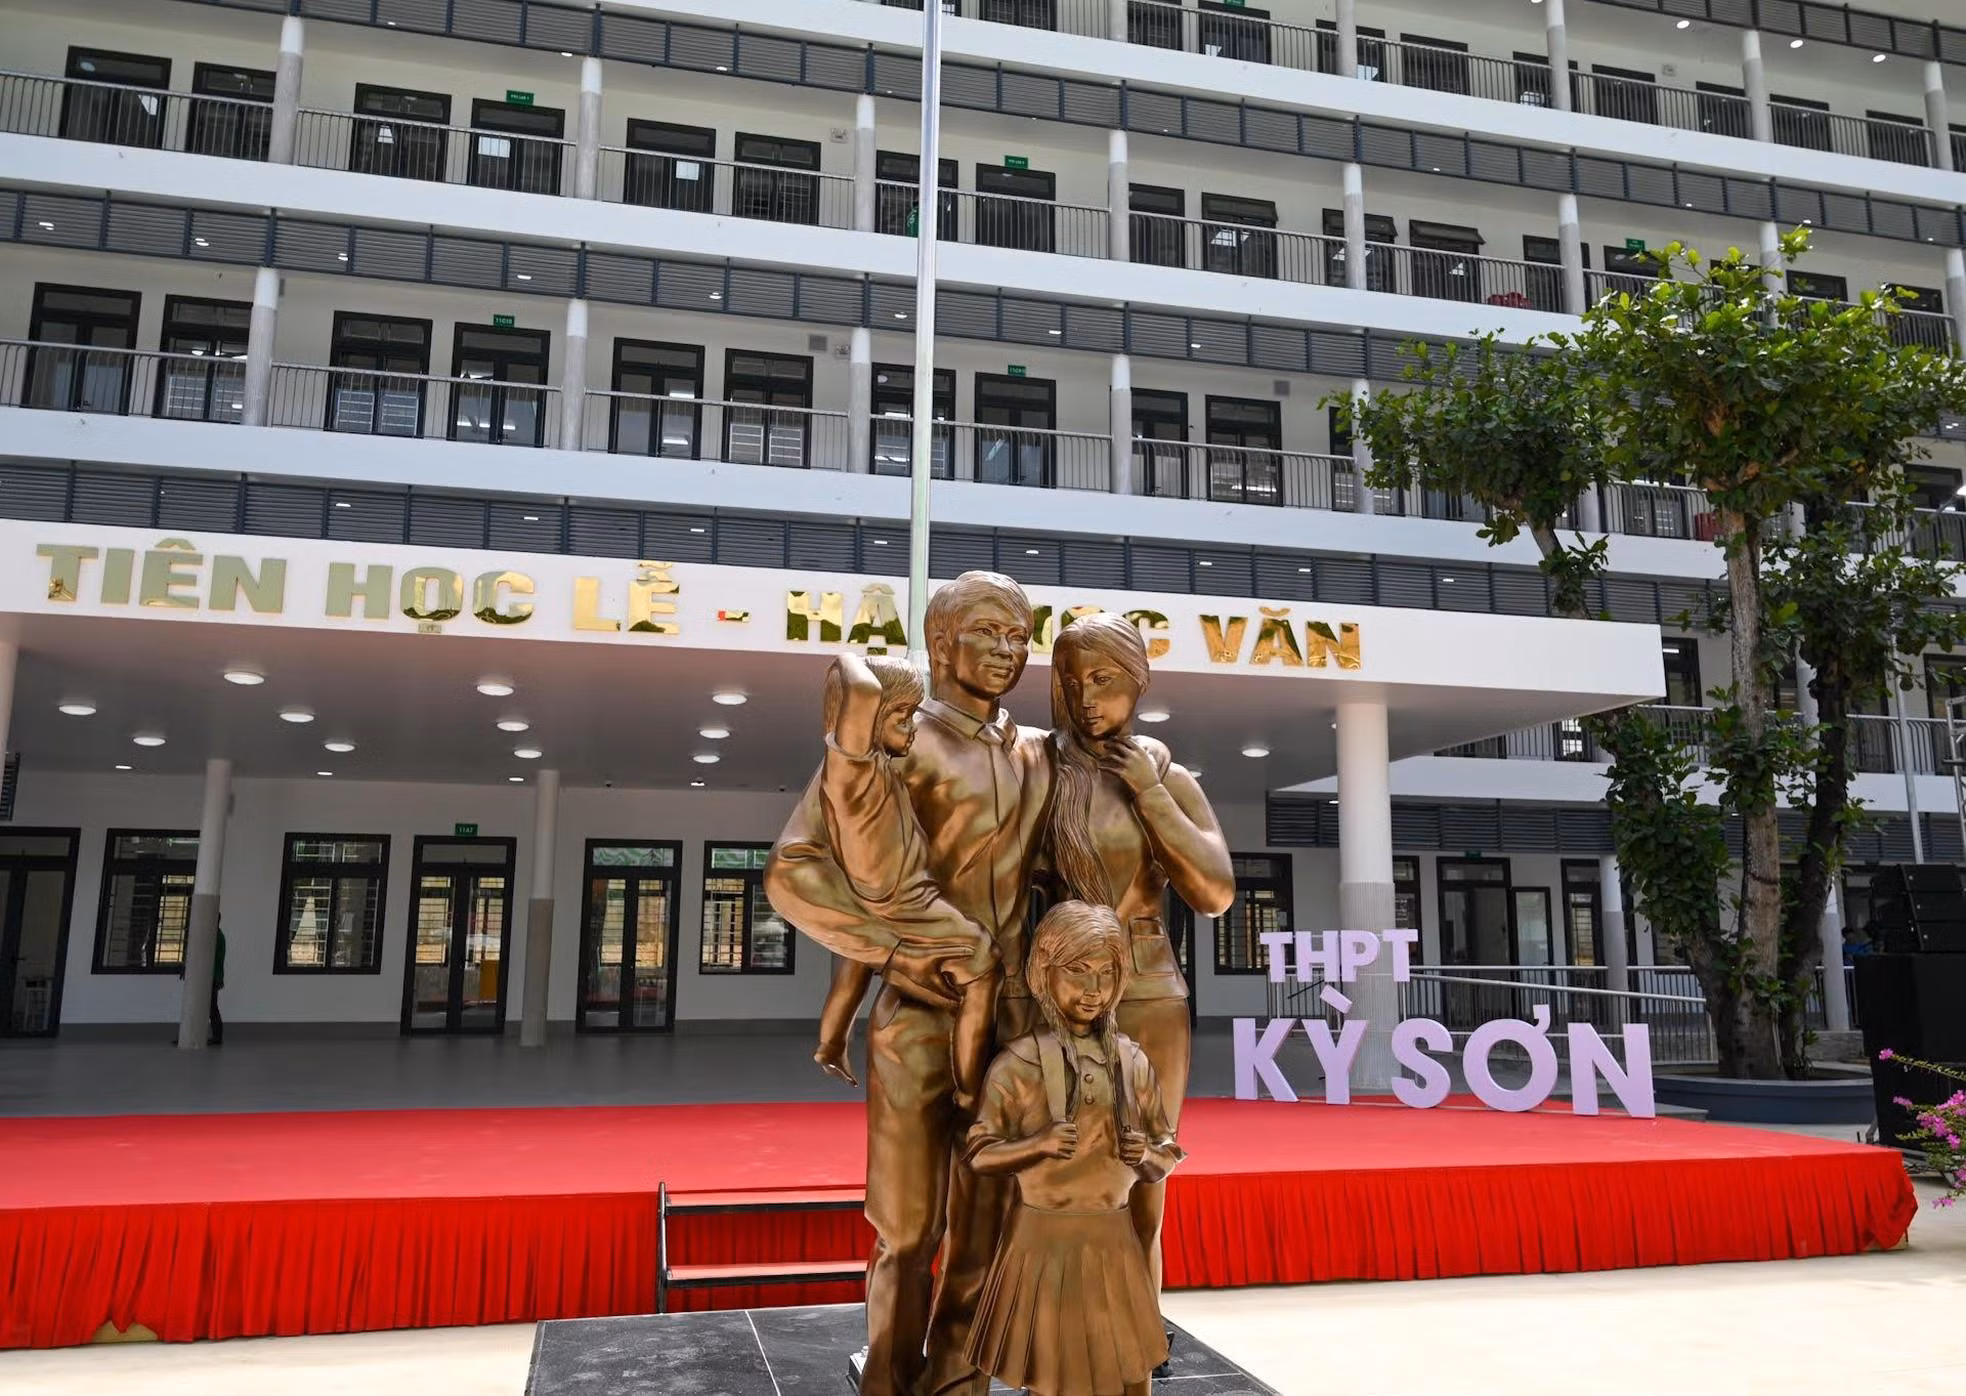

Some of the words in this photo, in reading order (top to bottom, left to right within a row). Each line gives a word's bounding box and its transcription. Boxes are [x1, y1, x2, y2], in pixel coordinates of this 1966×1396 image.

[36, 537, 287, 614] TIÊN
[325, 563, 535, 635] HỌC
[575, 561, 681, 634] LỄ
[787, 583, 908, 656] HẬ
[1199, 606, 1363, 670] VĂN
[1260, 928, 1419, 983] THPT
[1232, 984, 1370, 1105] KỲ
[1391, 1004, 1657, 1119] SƠN
